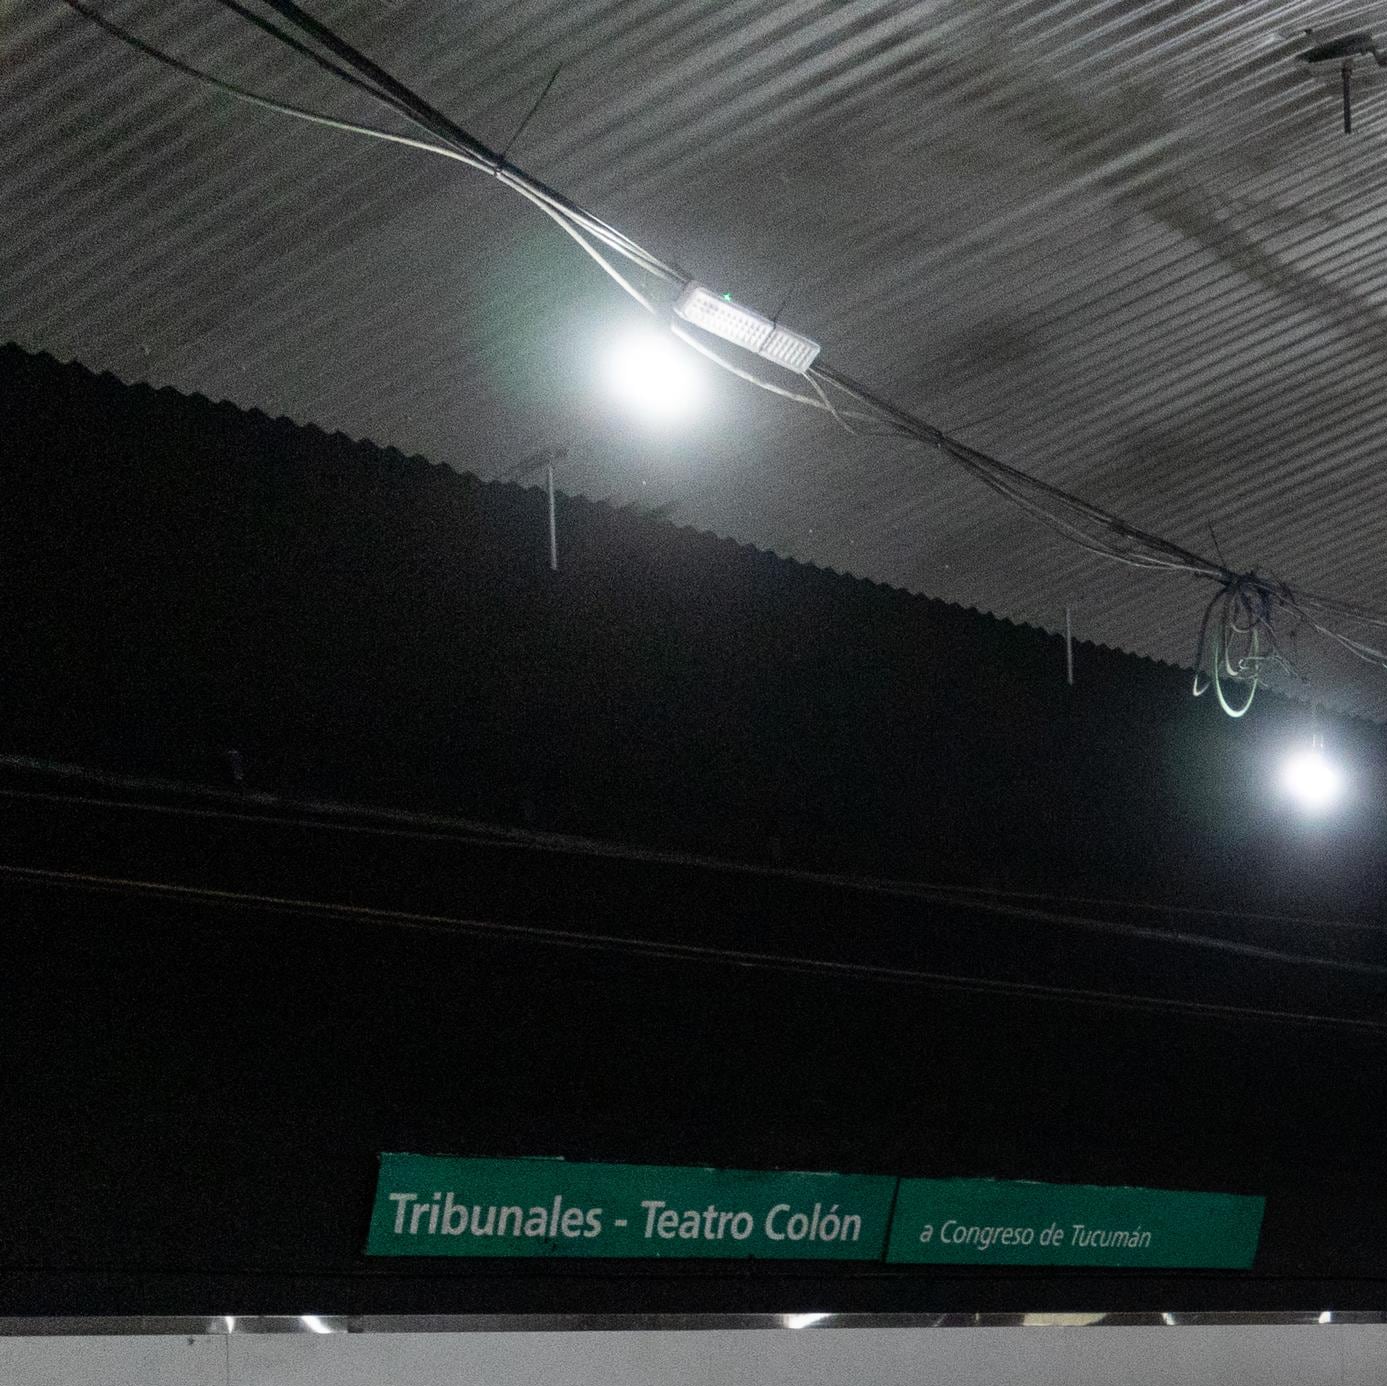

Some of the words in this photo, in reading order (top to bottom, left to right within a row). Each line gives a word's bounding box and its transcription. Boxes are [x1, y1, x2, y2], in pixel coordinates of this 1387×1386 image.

[387, 1191, 604, 1238] Tribunales
[640, 1200, 755, 1240] Teatro
[764, 1202, 863, 1242] Colón
[919, 1223, 934, 1243] a
[939, 1219, 1035, 1251] Congreso
[1039, 1221, 1065, 1247] de
[1070, 1223, 1153, 1249] Tucumán
